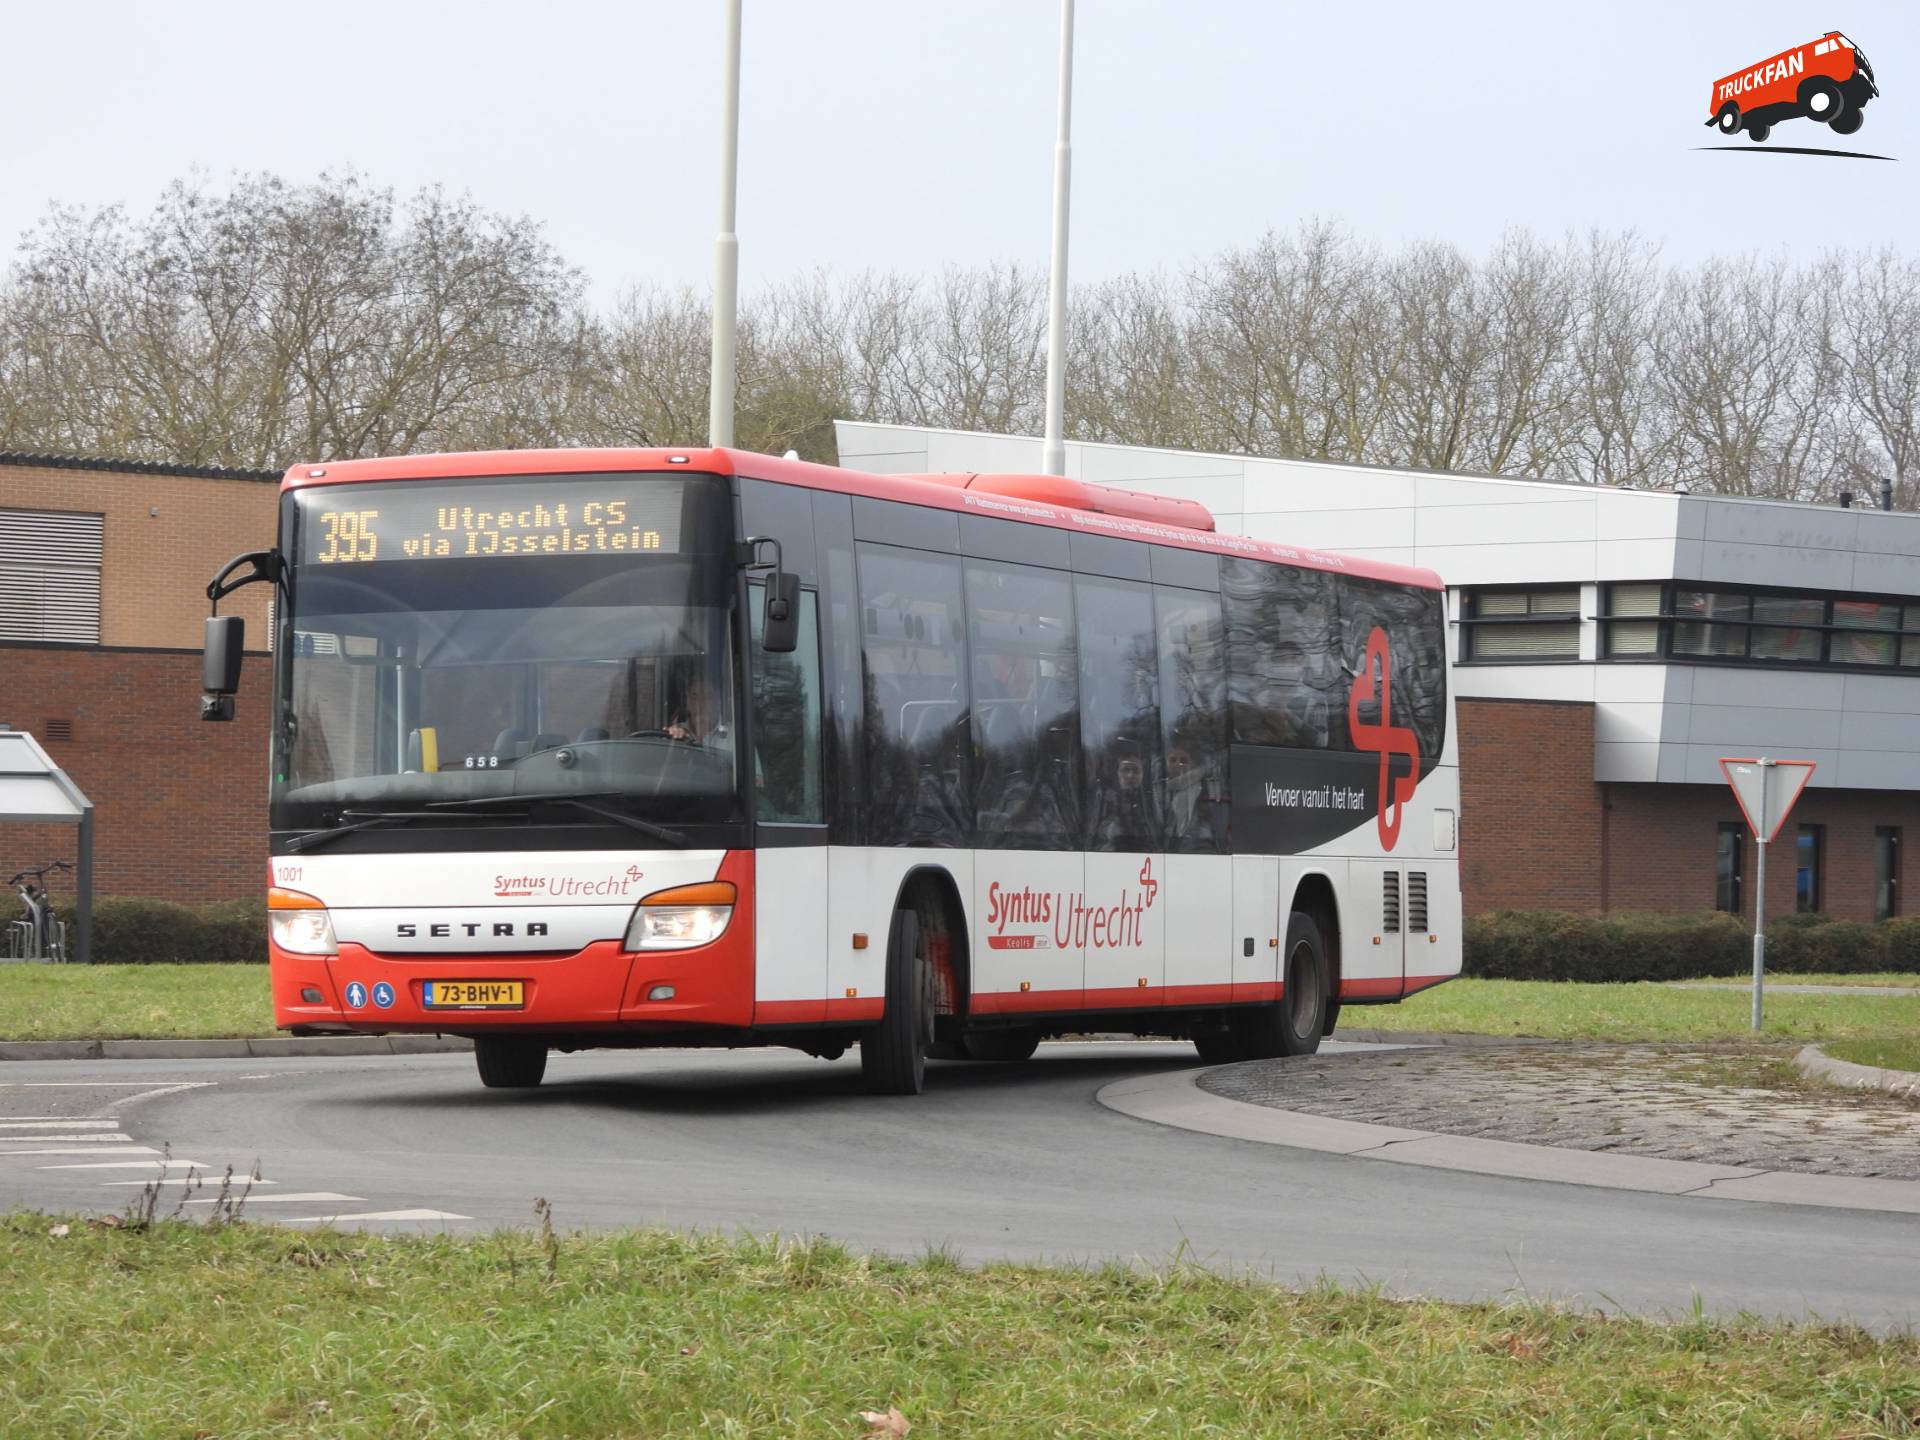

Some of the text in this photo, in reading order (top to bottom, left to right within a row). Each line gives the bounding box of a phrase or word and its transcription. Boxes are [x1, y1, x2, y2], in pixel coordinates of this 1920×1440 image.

[437, 501, 627, 531] Utrecht CS
[319, 510, 378, 562] 395
[403, 526, 660, 557] via IJsselstein
[465, 756, 499, 767] 658
[1265, 781, 1364, 810] Vervoer vanuit het hart
[278, 866, 302, 882] 1001
[494, 875, 630, 896] Syntus Utrecht
[987, 881, 1144, 949] Syntus Utrecht
[397, 922, 549, 938] SETRA
[440, 985, 514, 1002] 73-BHV-1
